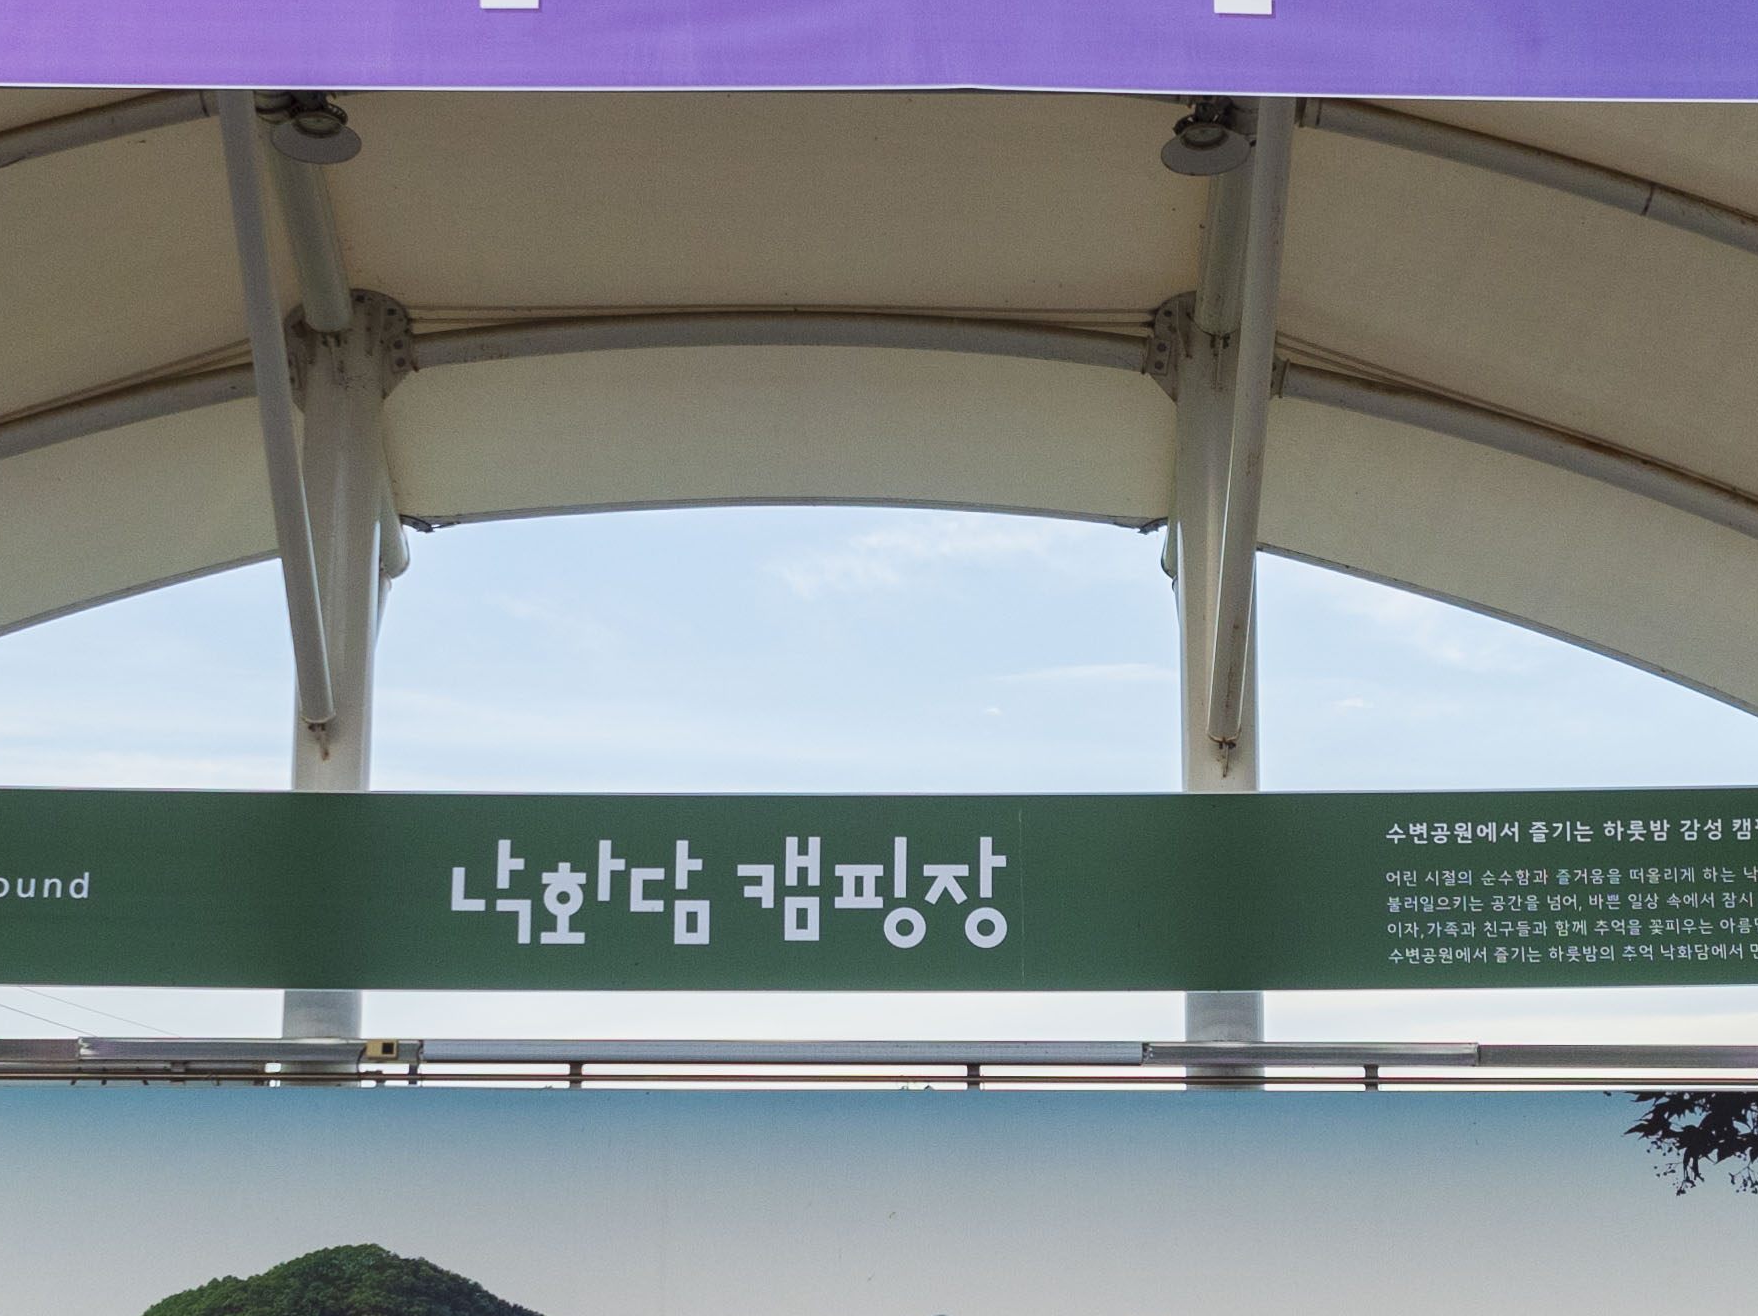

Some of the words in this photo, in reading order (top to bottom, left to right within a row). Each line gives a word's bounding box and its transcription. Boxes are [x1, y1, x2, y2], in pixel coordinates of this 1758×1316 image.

[1385, 821, 1519, 845] 수변공원에서
[1528, 820, 1594, 843] 즐기는
[1602, 819, 1671, 842] 하룻밤
[1679, 818, 1722, 841] 감성
[1385, 870, 1417, 887] 어린
[1425, 869, 1472, 887] 시절의
[1481, 868, 1548, 886] 순수함과
[1556, 868, 1622, 885] 즐거움을
[1629, 867, 1695, 884] 떠올리게
[1702, 866, 1736, 883] 하는
[451, 839, 710, 945] 낙화담
[737, 836, 1008, 949] 캠핑장
[1490, 894, 1540, 912] 공간을
[1547, 894, 1582, 912] 넘어,
[1588, 893, 1621, 910] 바쁜
[1627, 892, 1659, 910] 일상
[1666, 892, 1715, 909] 속에서
[1722, 891, 1753, 909] 잠시
[1483, 920, 1548, 938] 친구들과
[1554, 919, 1587, 937] 함께
[1594, 919, 1642, 936] 추억을
[1648, 918, 1714, 935] 꽃피우는
[1388, 946, 1487, 965] 수변공원에서
[1493, 946, 1542, 964] 즐기는
[1548, 945, 1615, 963] 하룻밤의
[1622, 944, 1654, 962] 추억
[1660, 943, 1743, 961] 낙화담에서
